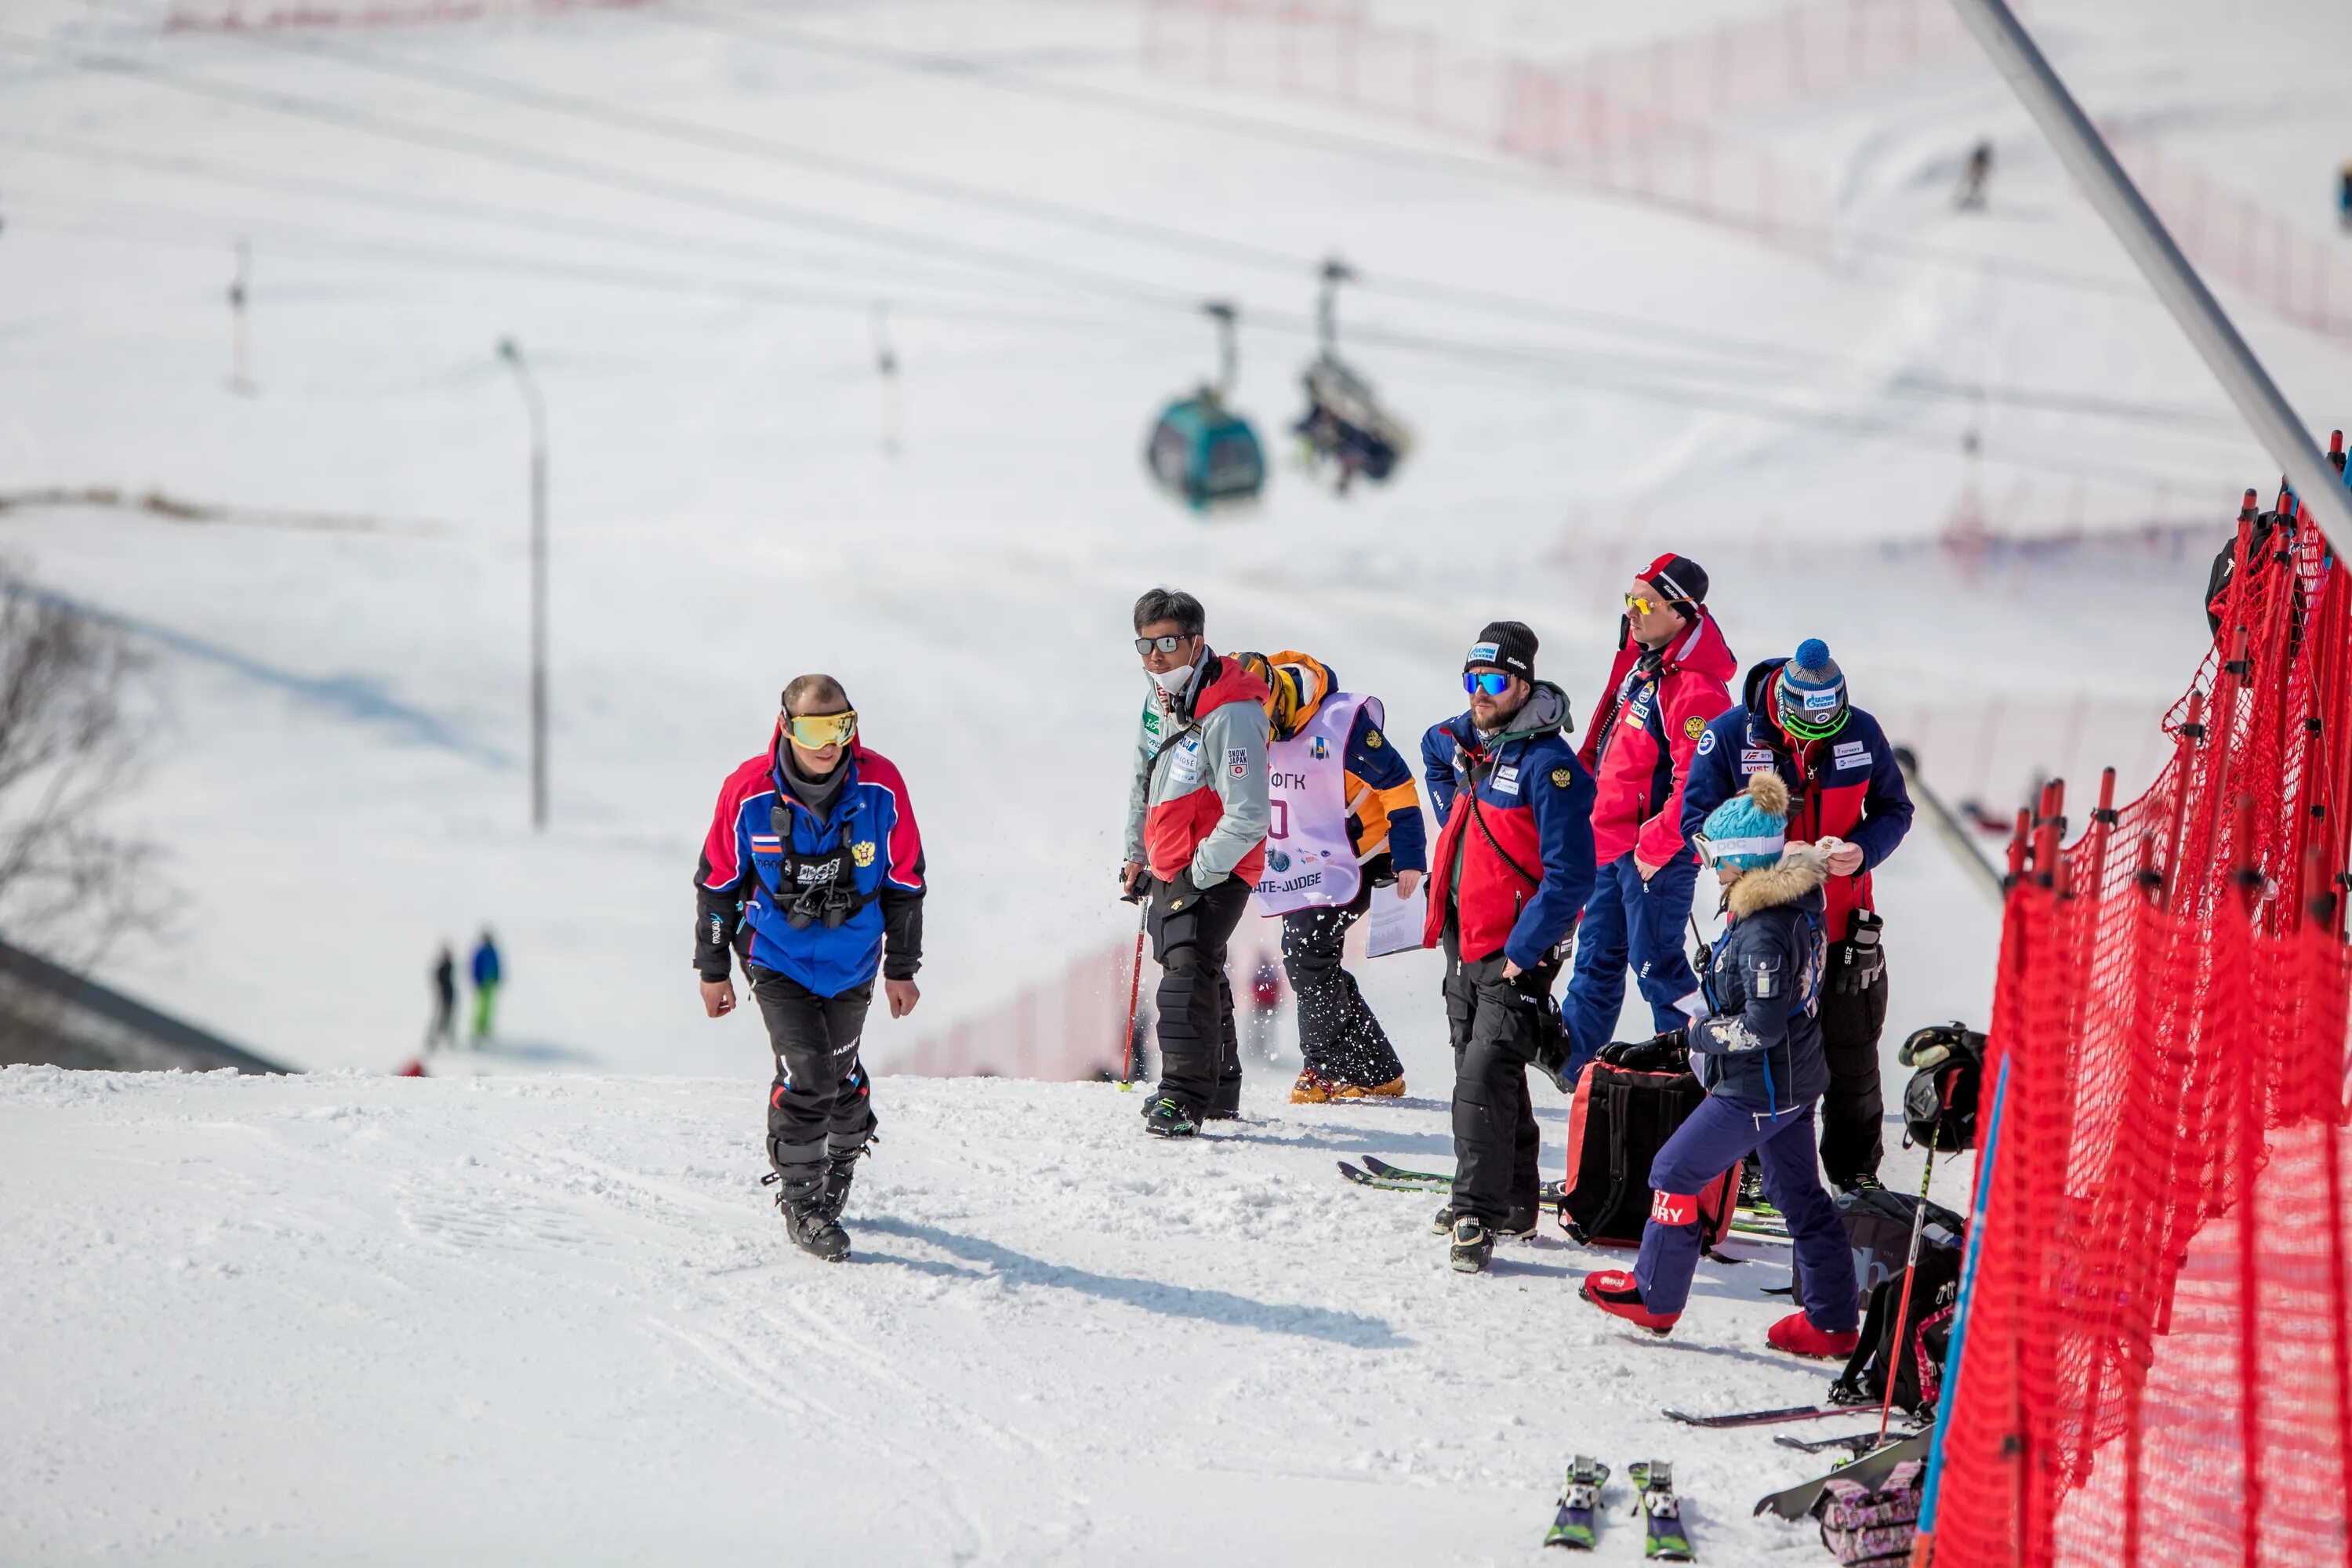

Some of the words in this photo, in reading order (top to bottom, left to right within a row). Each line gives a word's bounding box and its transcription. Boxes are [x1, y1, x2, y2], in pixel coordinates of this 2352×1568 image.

[1229, 750, 1247, 758] SNOW
[1229, 757, 1247, 765] JAPAN
[1271, 772, 1305, 789] ФГК
[1251, 872, 1321, 894] ATE-JUDGE
[1844, 946, 1853, 965] SEIZ
